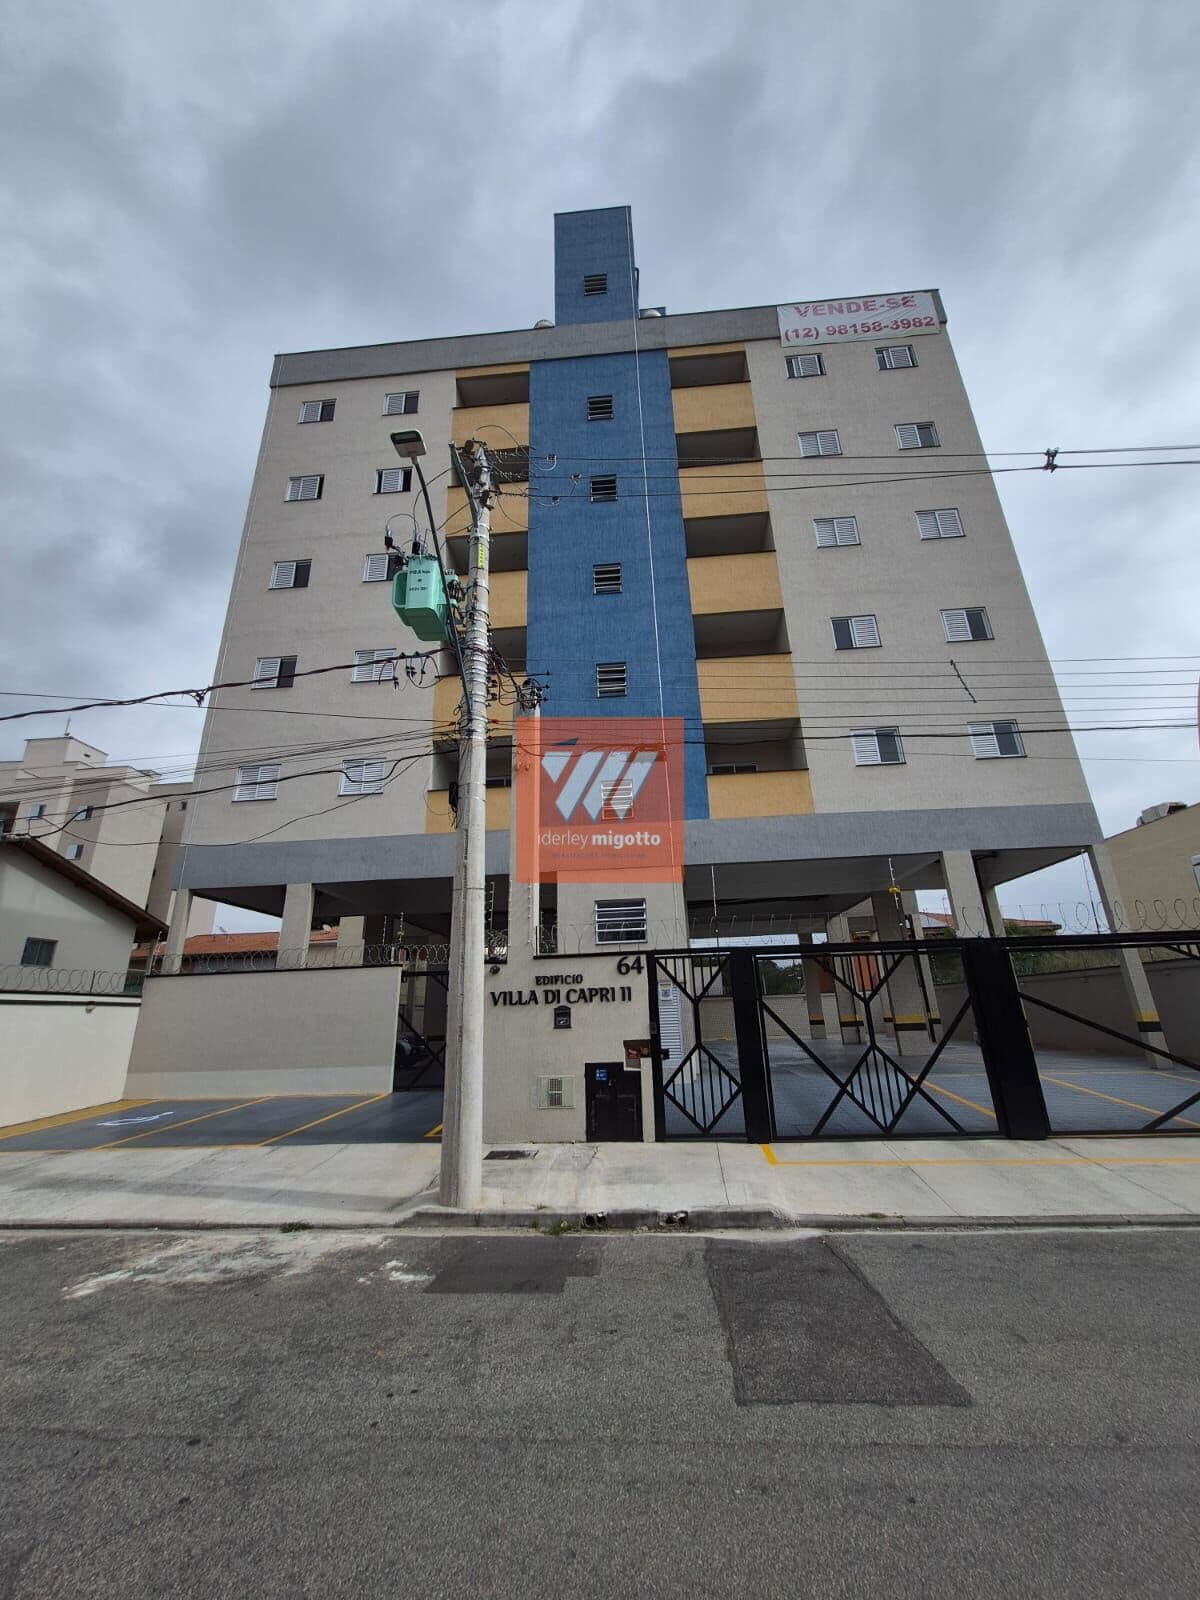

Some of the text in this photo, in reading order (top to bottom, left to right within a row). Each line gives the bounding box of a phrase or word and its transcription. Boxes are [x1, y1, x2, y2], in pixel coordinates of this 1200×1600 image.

[794, 295, 917, 317] VENDE-SE
[785, 316, 935, 341] (12) 98158-3982
[617, 956, 644, 975] 64
[535, 974, 583, 986] EDIFICIO
[490, 990, 538, 1006] VILLA
[543, 989, 560, 1004] DI
[566, 987, 616, 1004] CAPRI
